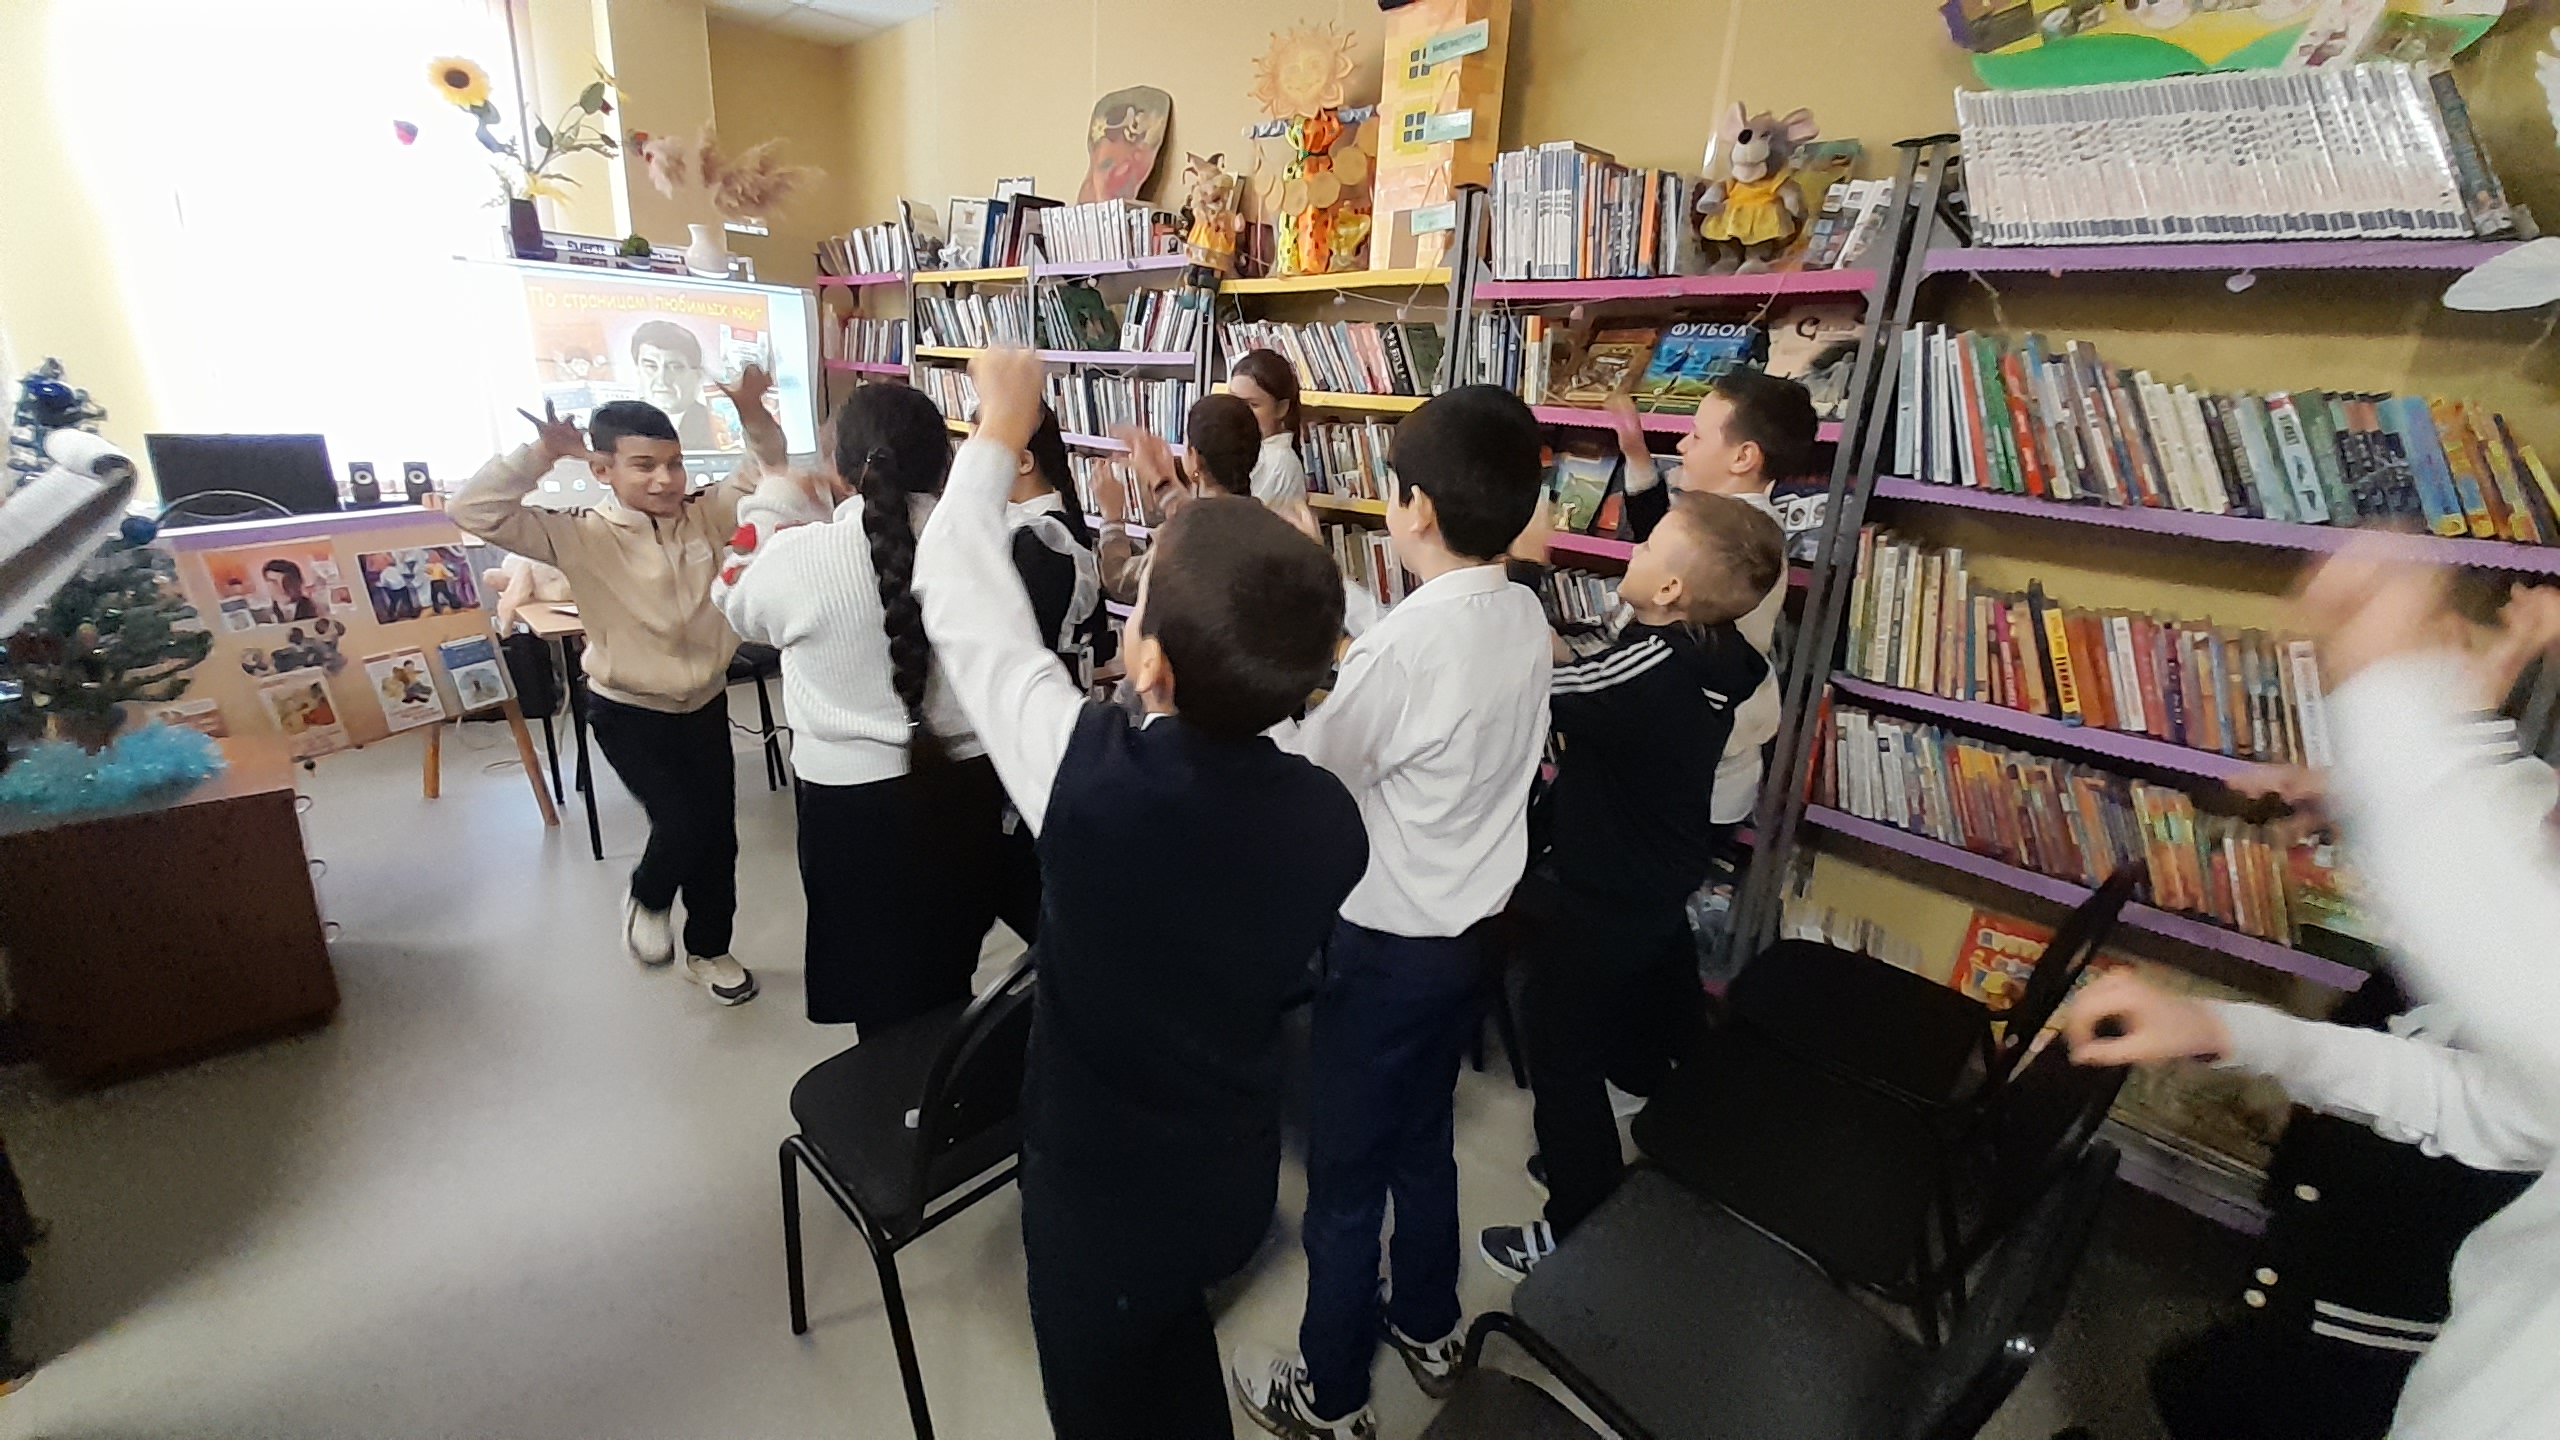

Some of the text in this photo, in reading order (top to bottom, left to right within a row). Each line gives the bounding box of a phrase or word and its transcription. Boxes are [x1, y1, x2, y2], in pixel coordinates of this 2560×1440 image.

[528, 286, 555, 309] По
[563, 292, 647, 311] страницам
[655, 292, 728, 316] любимых
[1671, 323, 1748, 337] ФУТБОЛ
